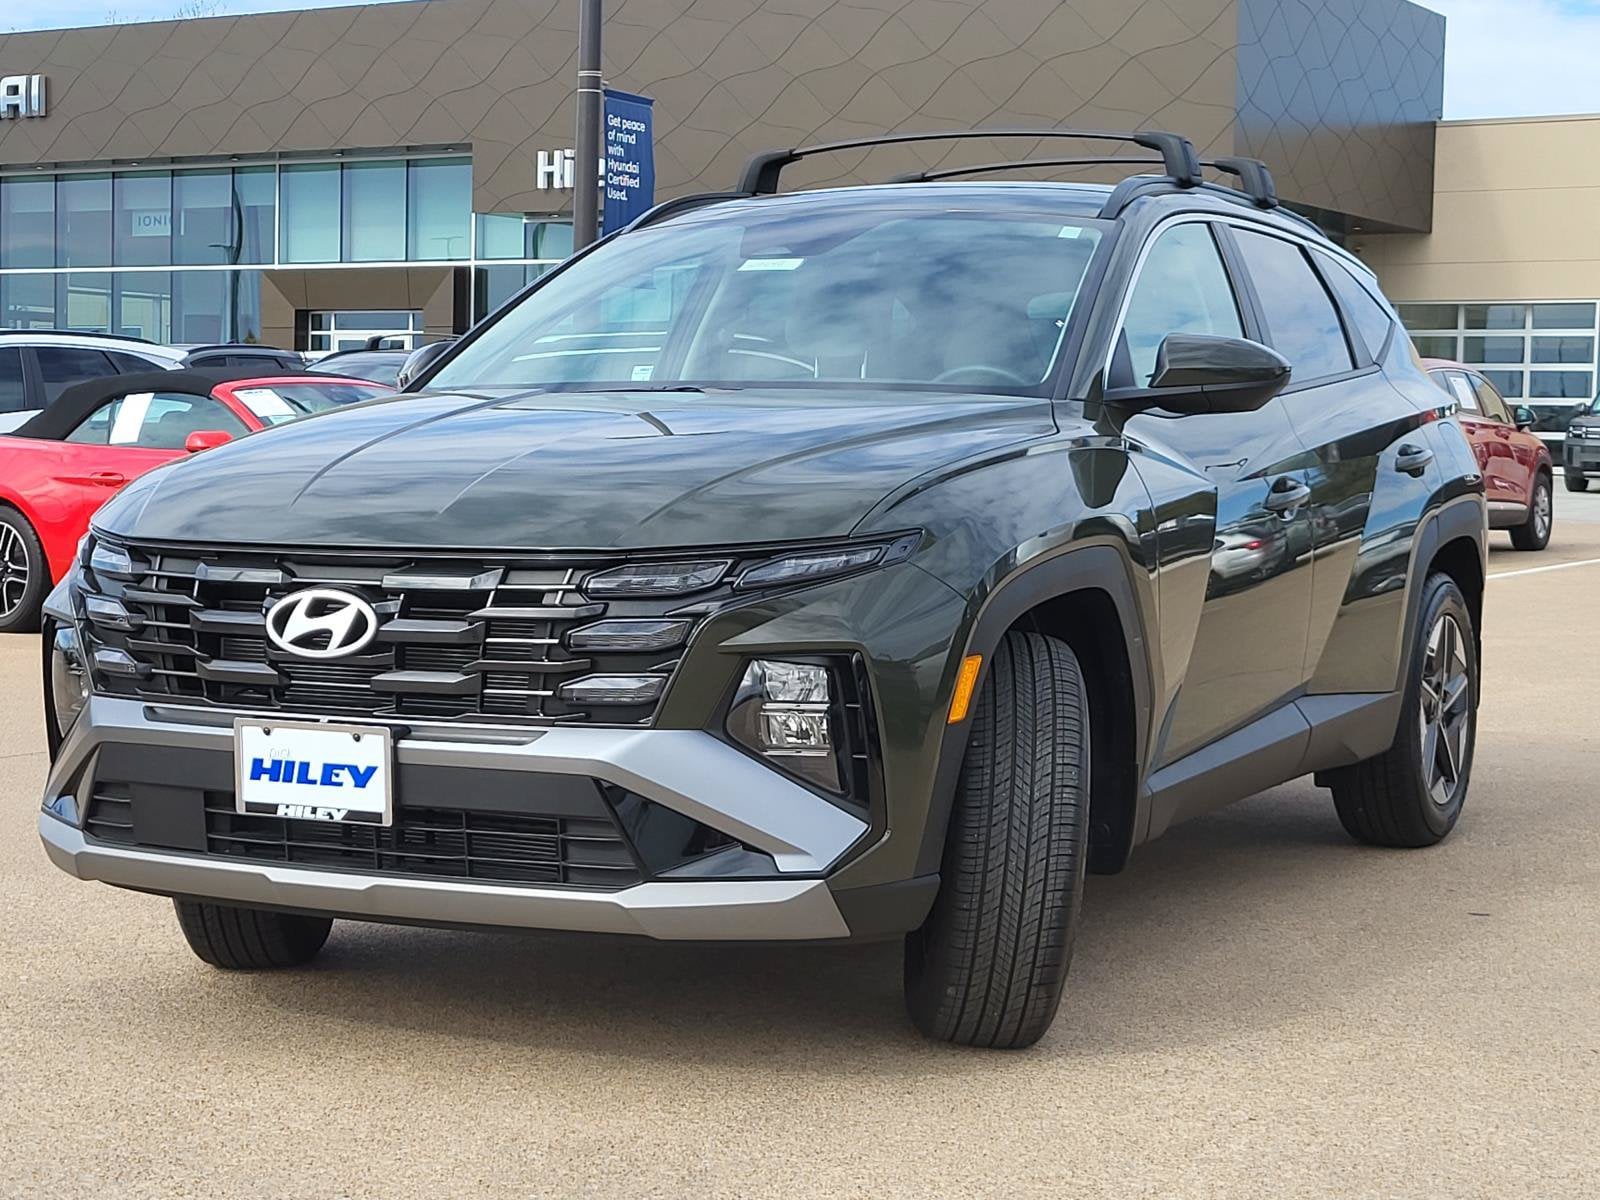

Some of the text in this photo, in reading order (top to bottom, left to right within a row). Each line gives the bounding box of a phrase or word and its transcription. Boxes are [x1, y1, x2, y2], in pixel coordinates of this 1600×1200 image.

[607, 114, 646, 132] Get peace
[607, 129, 636, 144] of mind
[607, 143, 624, 157] with
[607, 158, 640, 173] Hyundai
[607, 172, 640, 188] Certified
[607, 187, 628, 201] Used.
[136, 213, 172, 227] IONI
[249, 757, 379, 789] HILEY
[276, 803, 349, 821] HILEY
